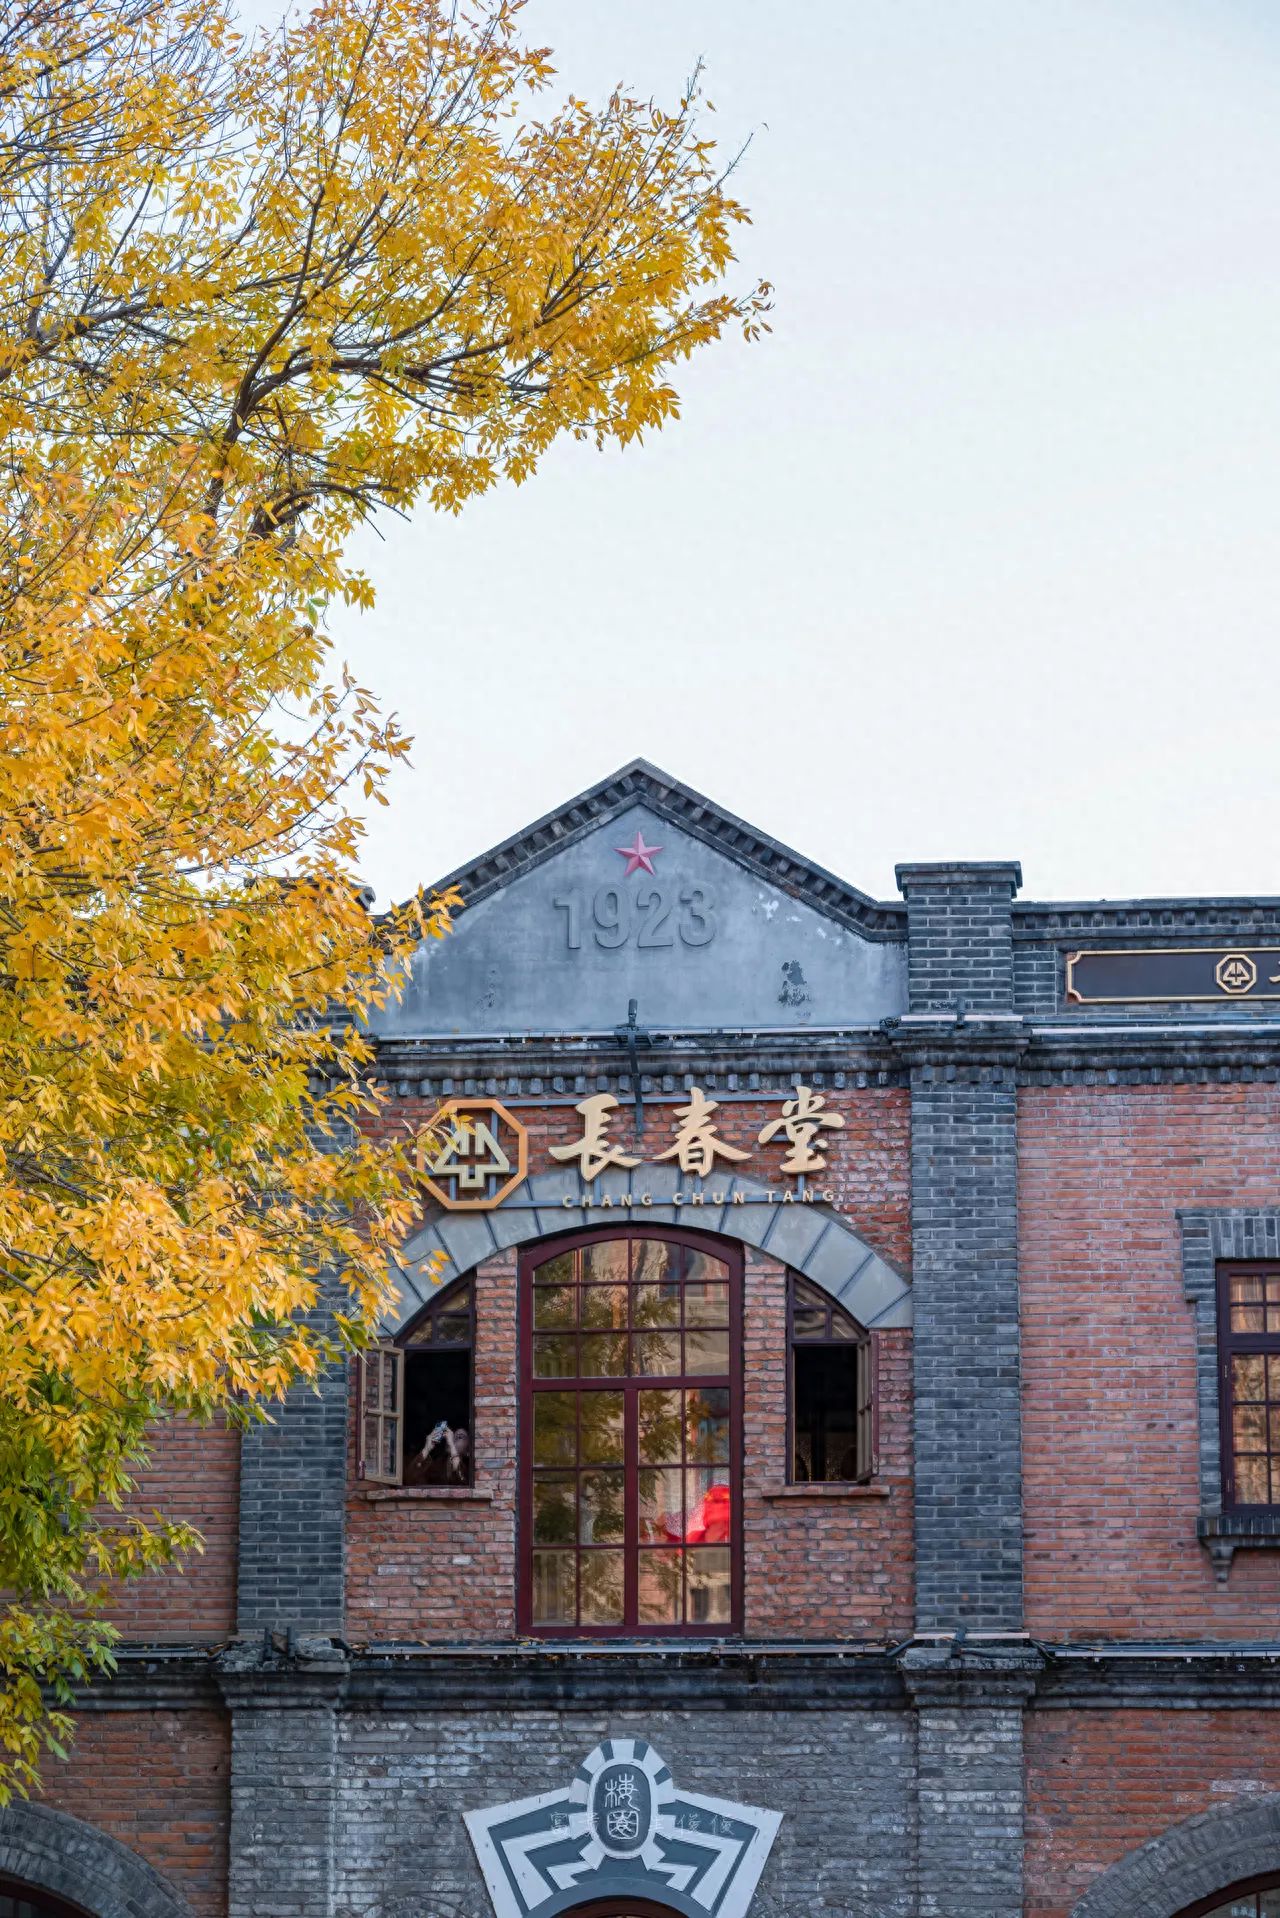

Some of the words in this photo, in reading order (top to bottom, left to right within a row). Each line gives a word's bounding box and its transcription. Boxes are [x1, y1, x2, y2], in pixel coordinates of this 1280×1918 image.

[553, 883, 717, 949] 1923
[548, 1086, 846, 1182] 長春堂
[562, 1194, 653, 1208] CHANG
[672, 1191, 746, 1205] CHUN
[765, 1189, 836, 1203] TANG
